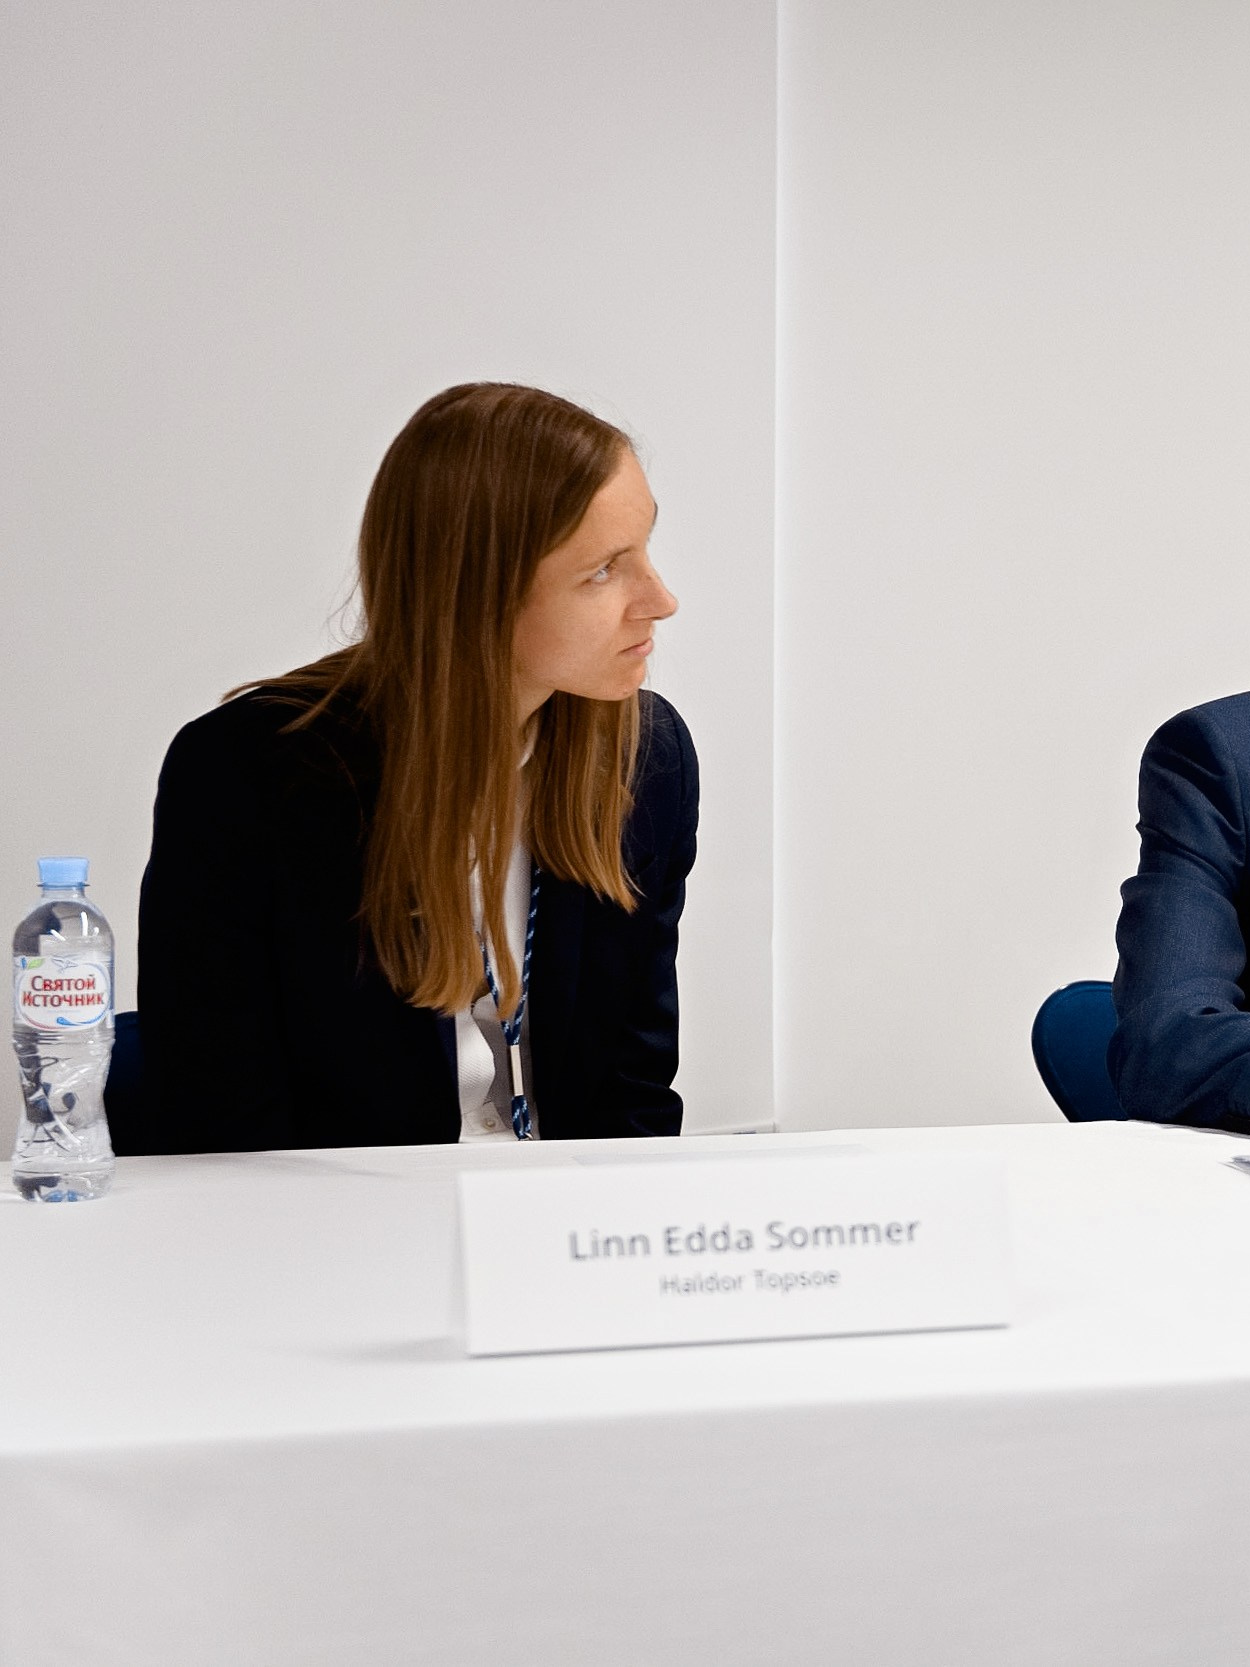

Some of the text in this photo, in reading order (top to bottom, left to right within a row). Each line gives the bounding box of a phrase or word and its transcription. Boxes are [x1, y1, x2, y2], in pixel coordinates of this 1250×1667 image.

[567, 1219, 920, 1262] Linn Edda Sommer
[753, 1268, 841, 1295] Topsoe
